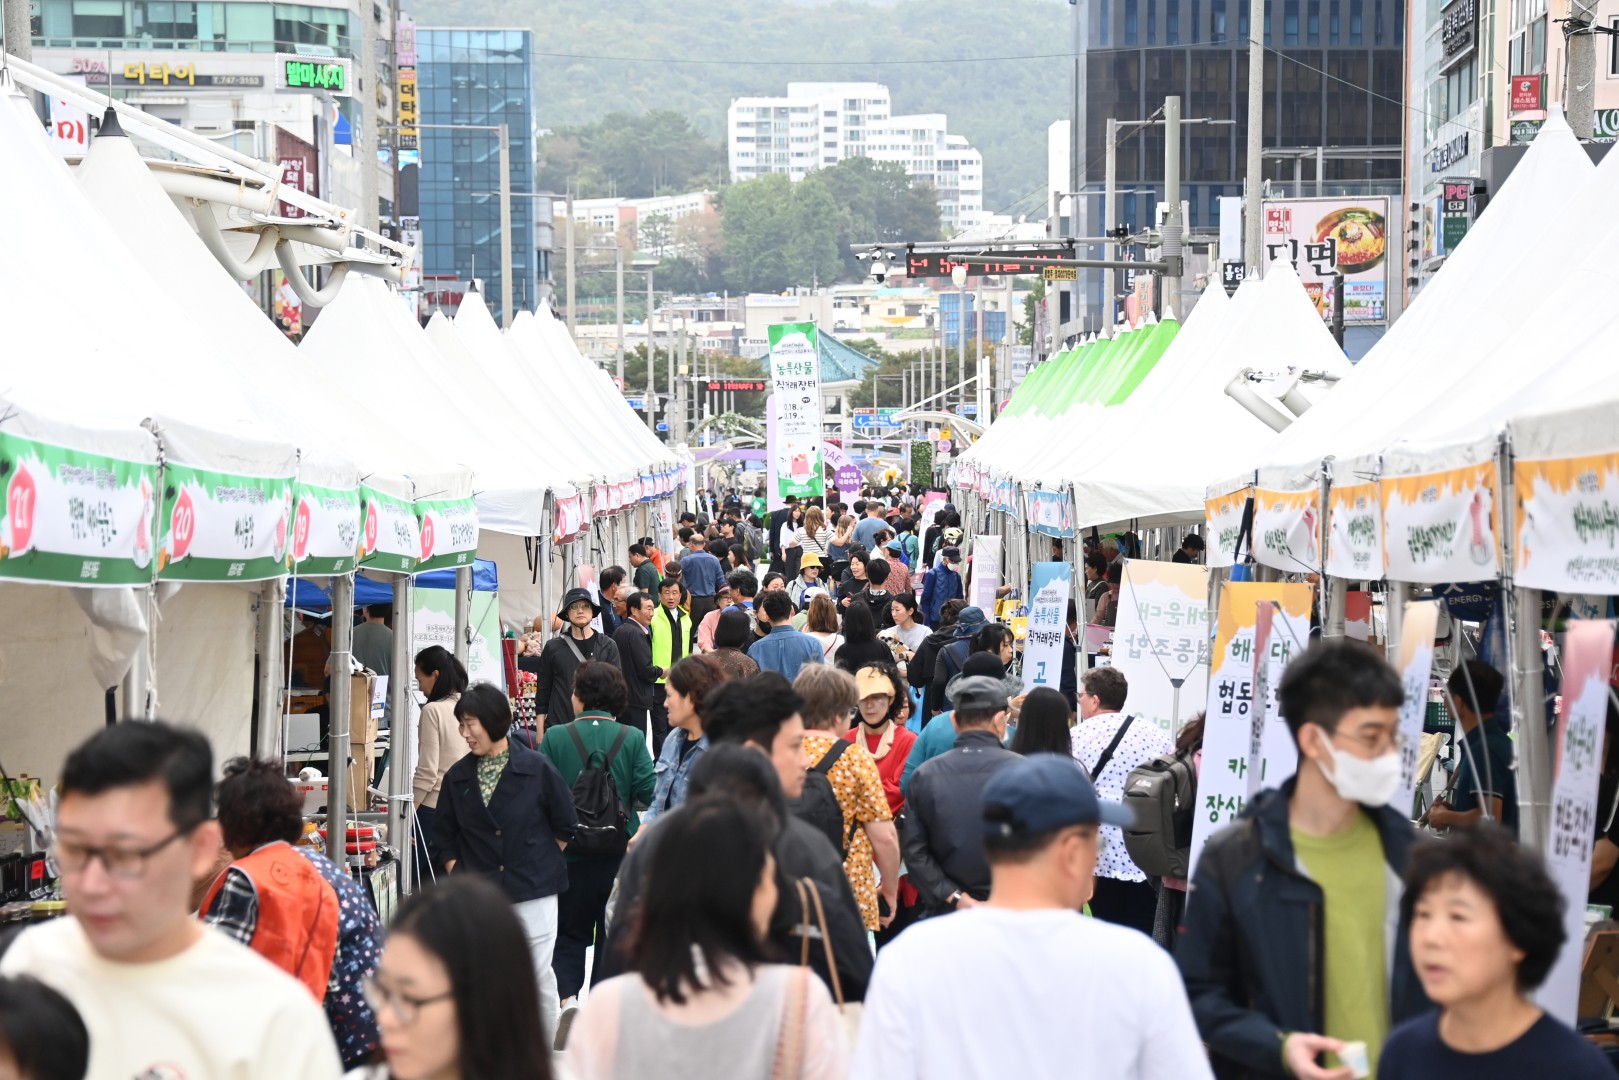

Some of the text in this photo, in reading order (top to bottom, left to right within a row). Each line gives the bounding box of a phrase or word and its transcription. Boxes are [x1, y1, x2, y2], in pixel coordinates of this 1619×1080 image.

[123, 61, 196, 86] 더타이
[286, 61, 345, 90] 발마사지
[1445, 184, 1468, 199] PC
[1450, 202, 1463, 210] 5F
[776, 361, 814, 376] 농특산물
[776, 380, 816, 391] 직거래장터
[12, 486, 31, 529] 21
[175, 506, 191, 540] 20
[368, 516, 375, 539] 18
[423, 525, 431, 548] 17
[1448, 594, 1484, 606] ENERGY
[1033, 607, 1060, 626] 농특산물
[1028, 629, 1063, 650] 직거래장터
[1231, 638, 1290, 663] 해대
[1033, 661, 1047, 684] 고
[1218, 679, 1285, 717] 협동
[1228, 757, 1267, 782] 카
